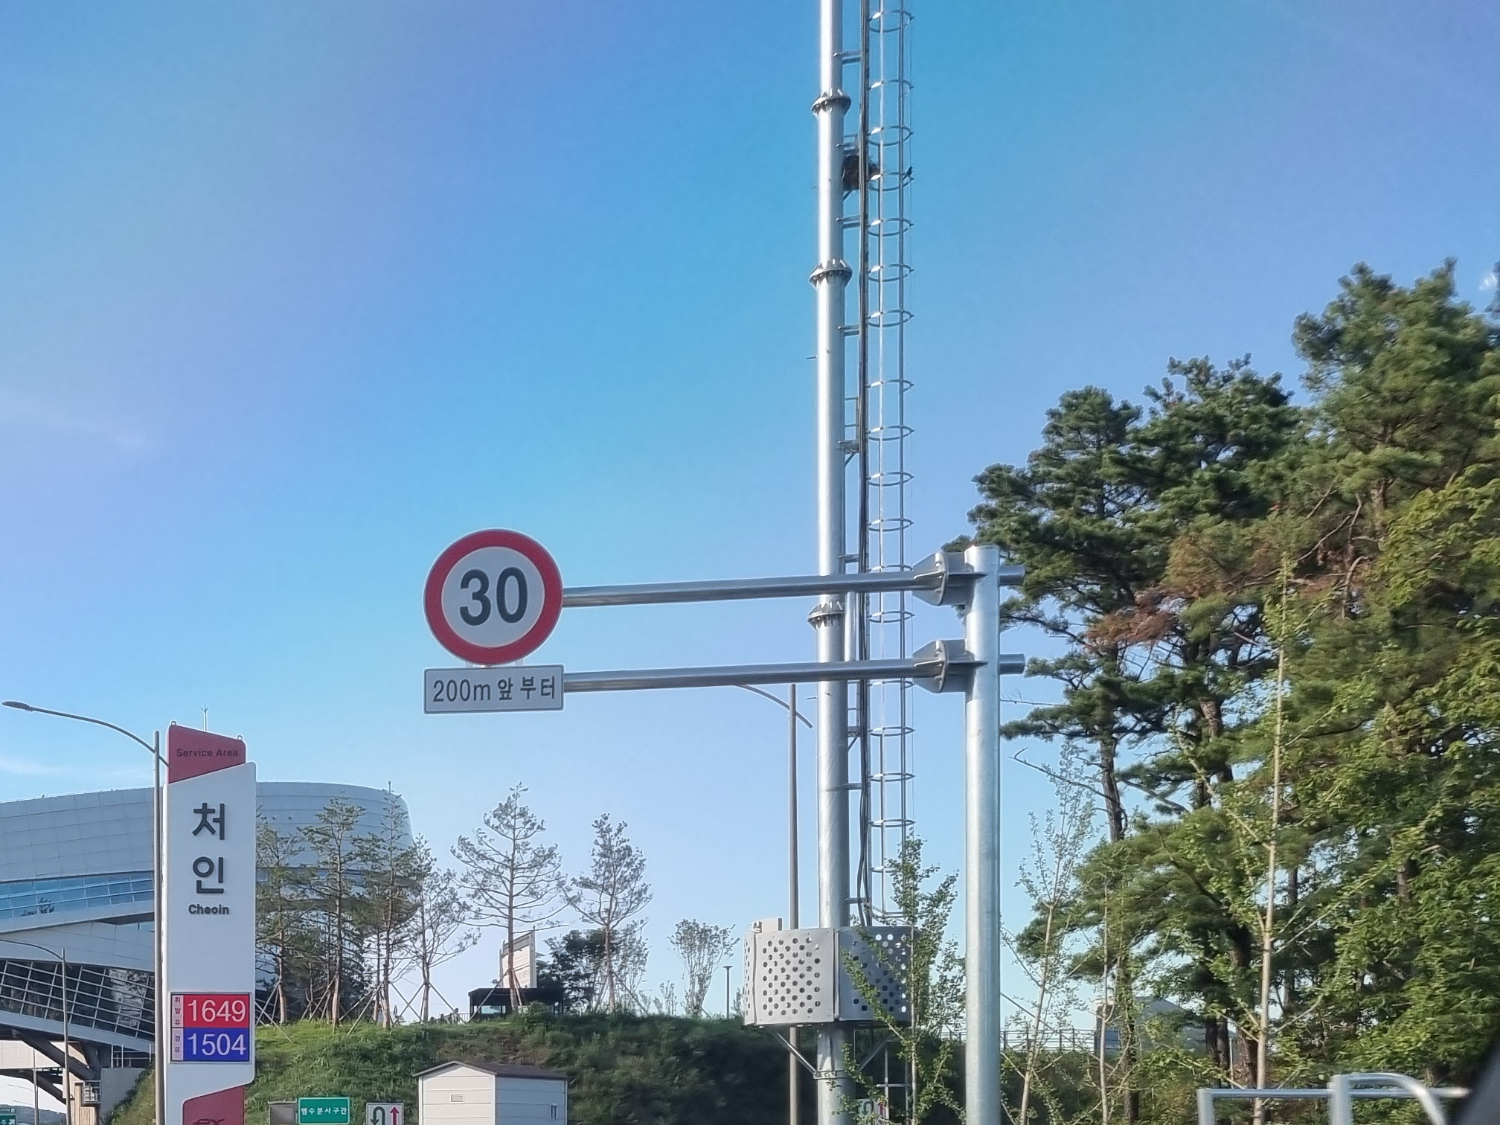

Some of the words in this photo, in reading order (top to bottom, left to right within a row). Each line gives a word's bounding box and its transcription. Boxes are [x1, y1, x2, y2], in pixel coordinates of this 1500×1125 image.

[459, 567, 528, 626] 30
[432, 680, 491, 702] 200m
[497, 678, 514, 700] 앞
[520, 676, 555, 699] 부터
[176, 748, 213, 757] Service
[216, 748, 239, 757] Area
[192, 802, 225, 894] 처인
[188, 903, 230, 915] Cheoin
[187, 999, 246, 1022] 1649
[187, 1032, 247, 1056] 1504
